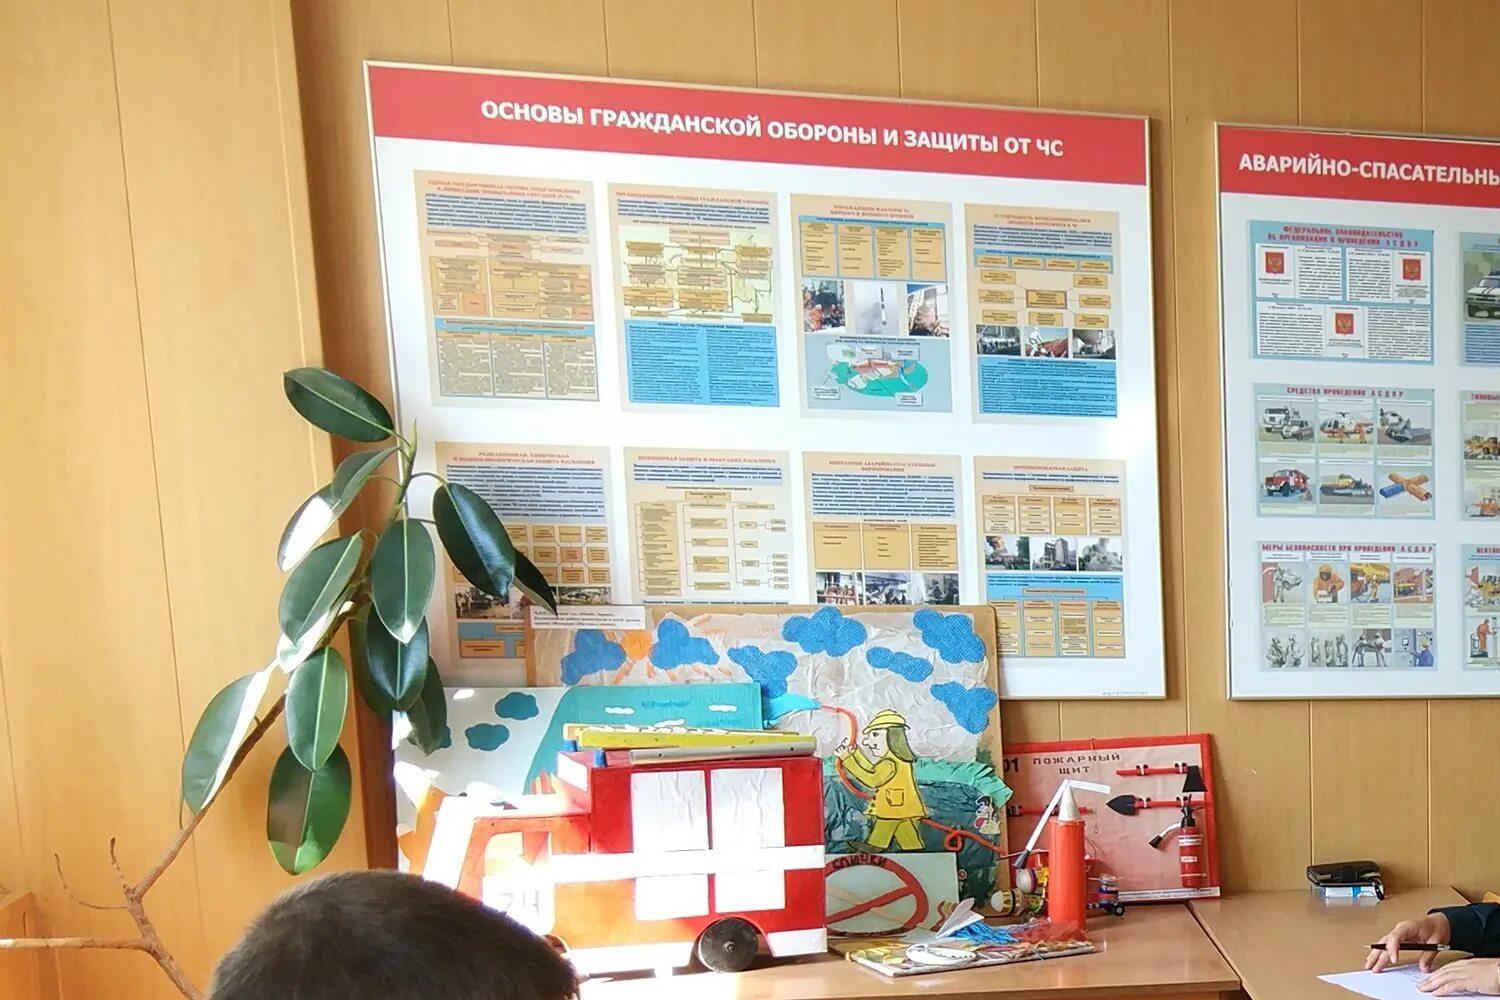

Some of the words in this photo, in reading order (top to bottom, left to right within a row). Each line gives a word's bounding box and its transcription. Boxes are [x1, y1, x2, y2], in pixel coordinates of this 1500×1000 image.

[480, 100, 583, 125] ОСНОВЫ
[590, 107, 761, 138] ГРАЖДАНСКОЙ
[767, 120, 877, 145] ОБОРОНЫ
[883, 129, 898, 146] И
[903, 129, 998, 153] ЗАЩИТЫ
[1004, 136, 1032, 155] ОТ
[1036, 139, 1064, 157] ЧС
[1032, 752, 1121, 765] ПОЖАРНЫЙ
[1059, 765, 1090, 775] ЩИТ
